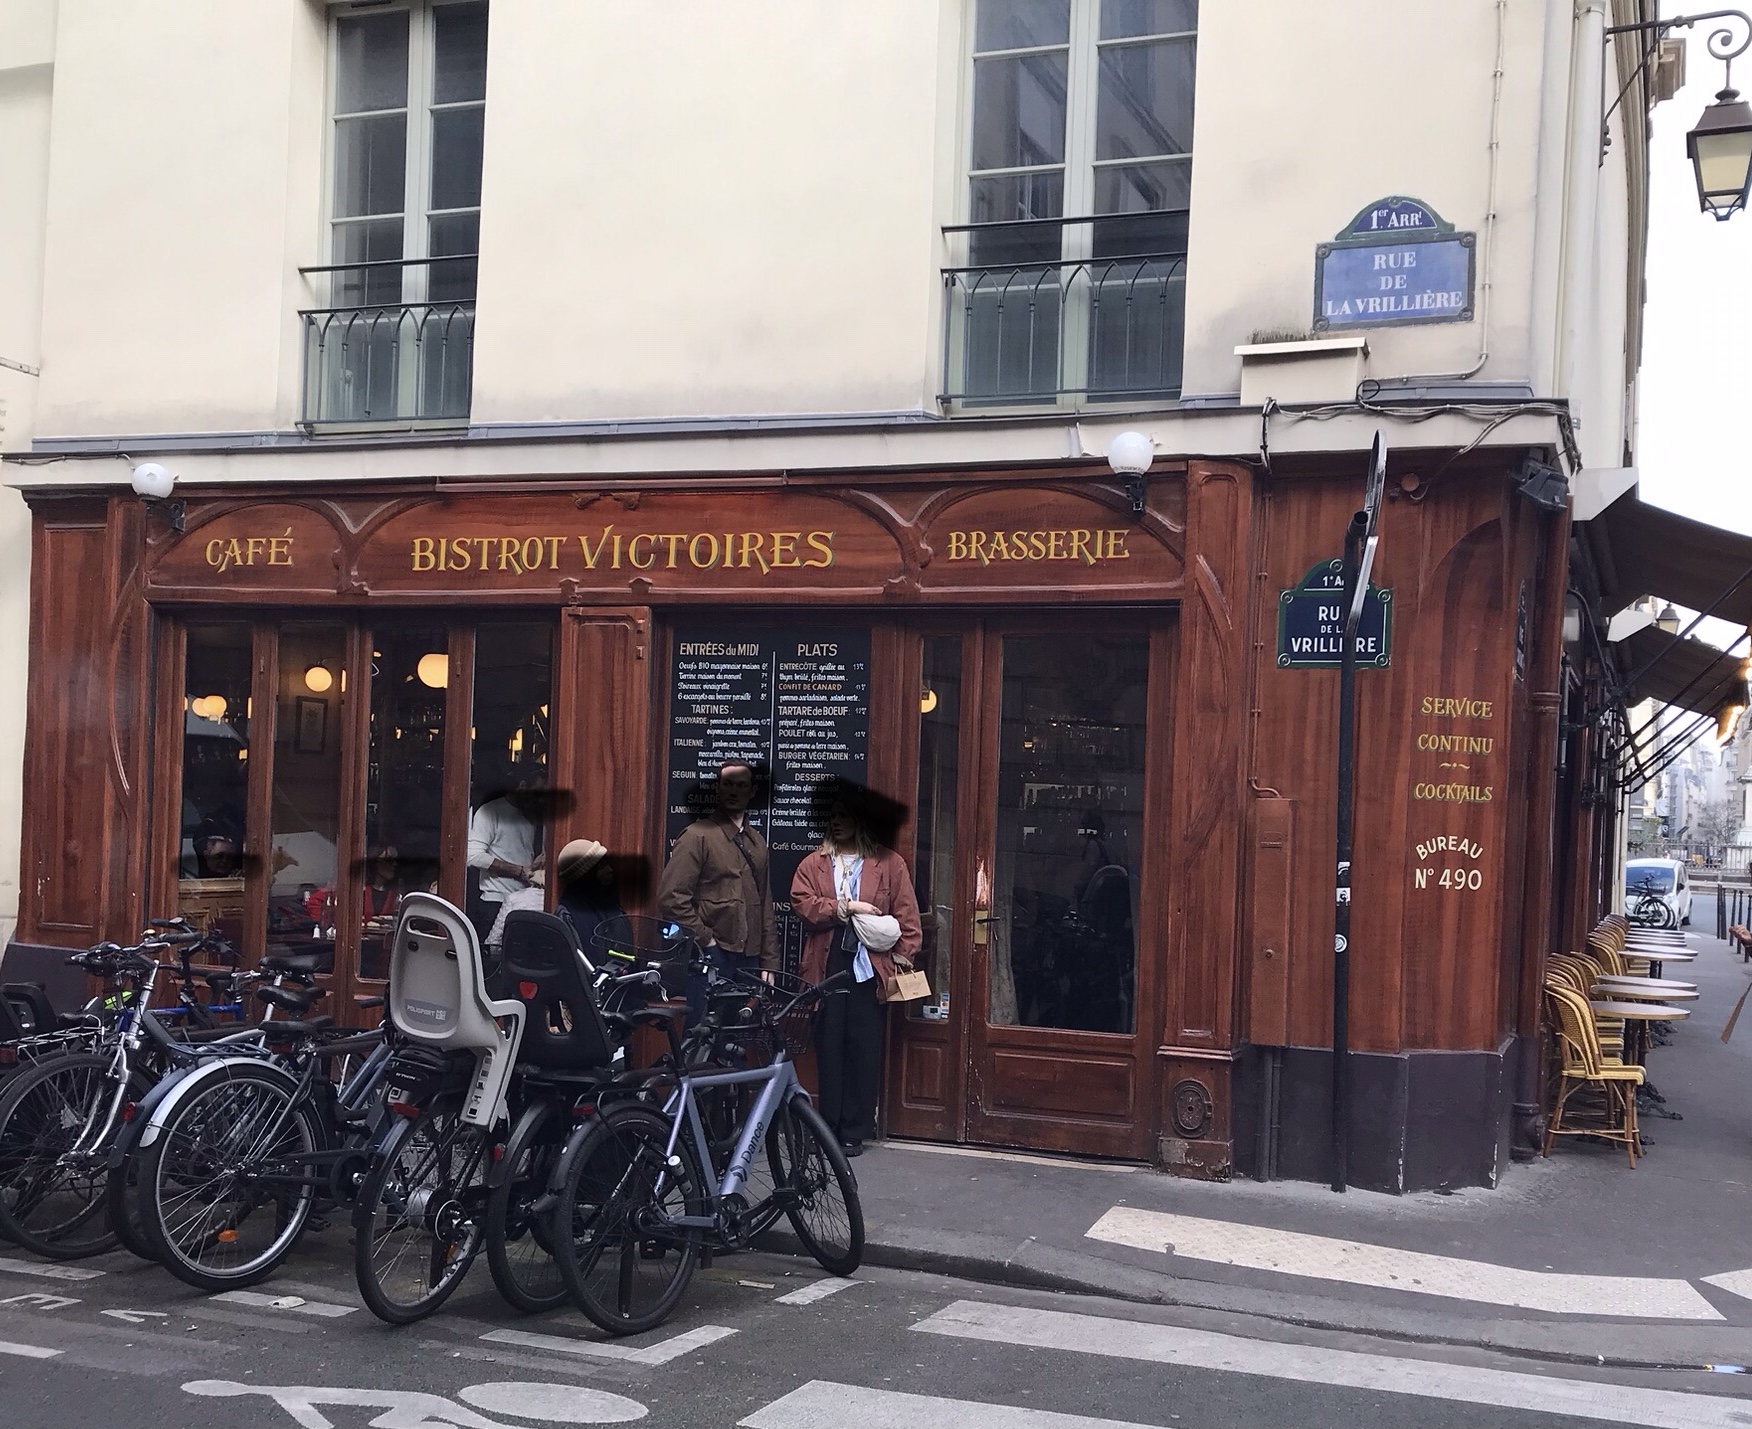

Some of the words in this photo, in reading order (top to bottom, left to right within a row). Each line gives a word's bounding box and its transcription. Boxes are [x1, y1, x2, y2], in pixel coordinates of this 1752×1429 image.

[1373, 251, 1416, 270] RUE
[1379, 274, 1407, 290] DE
[1326, 299, 1351, 316] LA
[1355, 290, 1463, 314] VRILLIÈRE
[205, 526, 294, 573] CAFÉ
[411, 536, 568, 576] BISTROT
[577, 524, 836, 576] VICTOIRES
[947, 529, 1130, 567] BRASSERIE
[1318, 606, 1340, 621] RU
[1320, 625, 1332, 634] DE
[680, 641, 725, 656] ENTRÉES
[726, 644, 736, 656] du
[738, 644, 759, 656] MIDI
[797, 644, 838, 656] PLATS
[1291, 637, 1376, 652] VRILLIRE
[698, 662, 710, 670] BIO
[780, 662, 817, 670] ENTRECÔTE
[778, 706, 812, 716] TARTARE
[812, 706, 822, 716] de
[1421, 696, 1493, 719] SERVICE
[778, 729, 806, 737] POULET
[1417, 734, 1494, 754] CONTINU
[778, 752, 806, 760] BURGER
[1415, 782, 1493, 804] COCKTAILS
[772, 842, 790, 850] Café
[1416, 836, 1484, 860] BUREAU
[1438, 868, 1482, 890] 490
[741, 1121, 764, 1164] Dance
